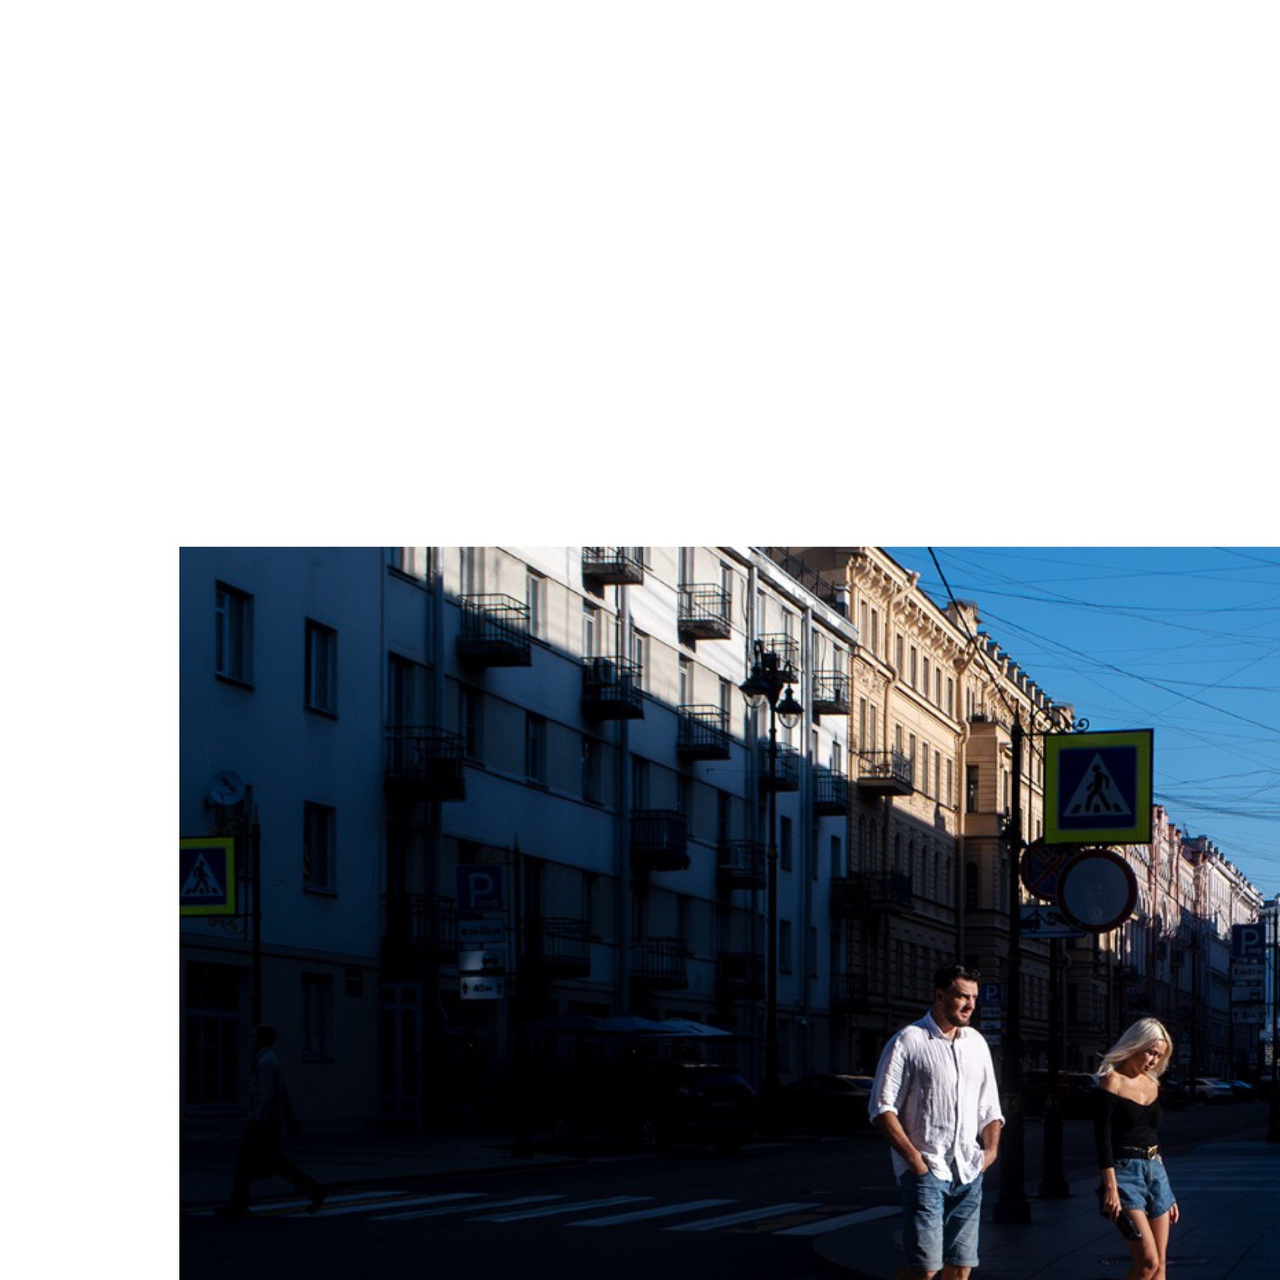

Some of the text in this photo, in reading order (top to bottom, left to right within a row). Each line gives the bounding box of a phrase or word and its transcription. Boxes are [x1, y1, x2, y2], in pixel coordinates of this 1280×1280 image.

[469, 871, 495, 910] P
[1241, 928, 1260, 955] P
[986, 985, 998, 1004] P
